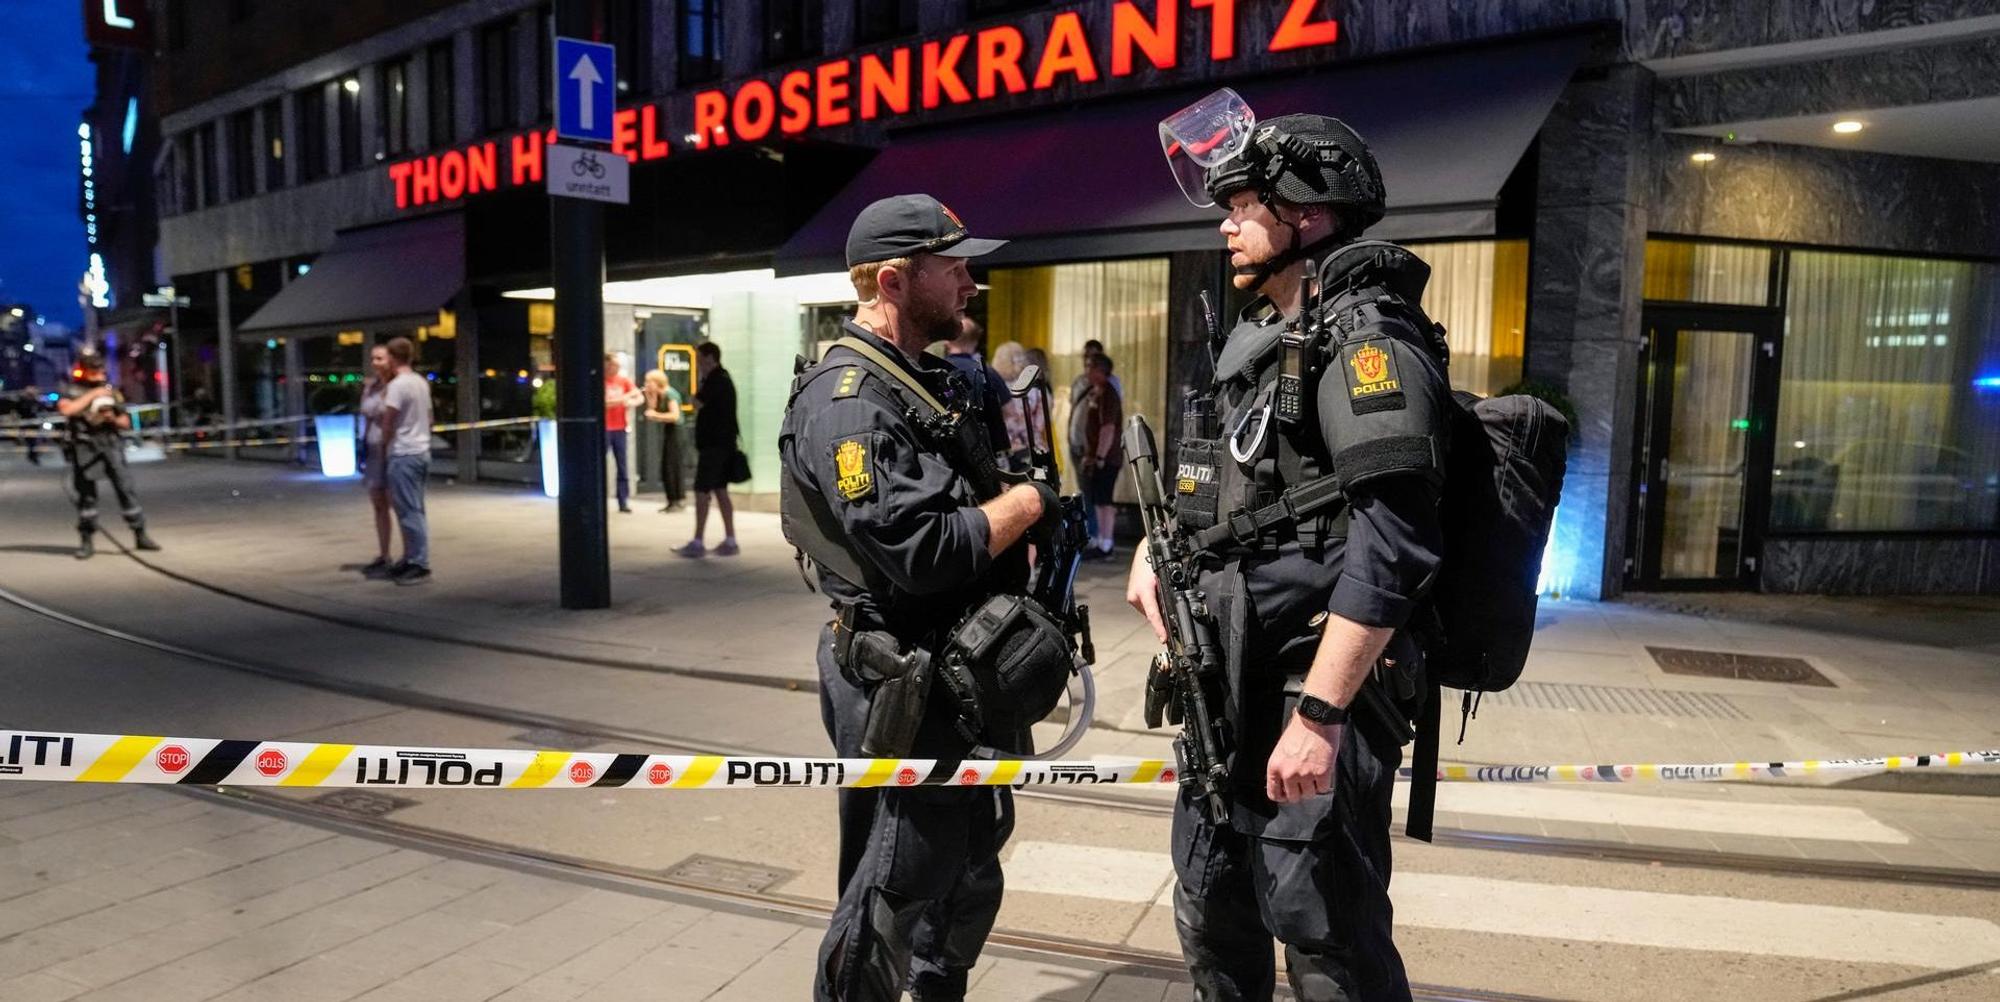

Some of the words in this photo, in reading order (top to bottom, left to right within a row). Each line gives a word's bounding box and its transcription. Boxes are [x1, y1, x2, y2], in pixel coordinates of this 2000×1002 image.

[389, 142, 497, 209] THON
[511, 104, 669, 186] HEL
[694, 0, 1337, 150] ROSENKRANTZ
[1353, 380, 1397, 396] POLITI
[1176, 463, 1214, 482] POLITI
[838, 473, 869, 491] POLITI
[0, 735, 74, 767] ITI
[159, 753, 187, 764] STOP
[259, 757, 284, 769] STOP
[356, 757, 503, 786] POLITI
[571, 767, 593, 779] STOP
[650, 769, 671, 780] STOP
[727, 761, 845, 785] POLITI
